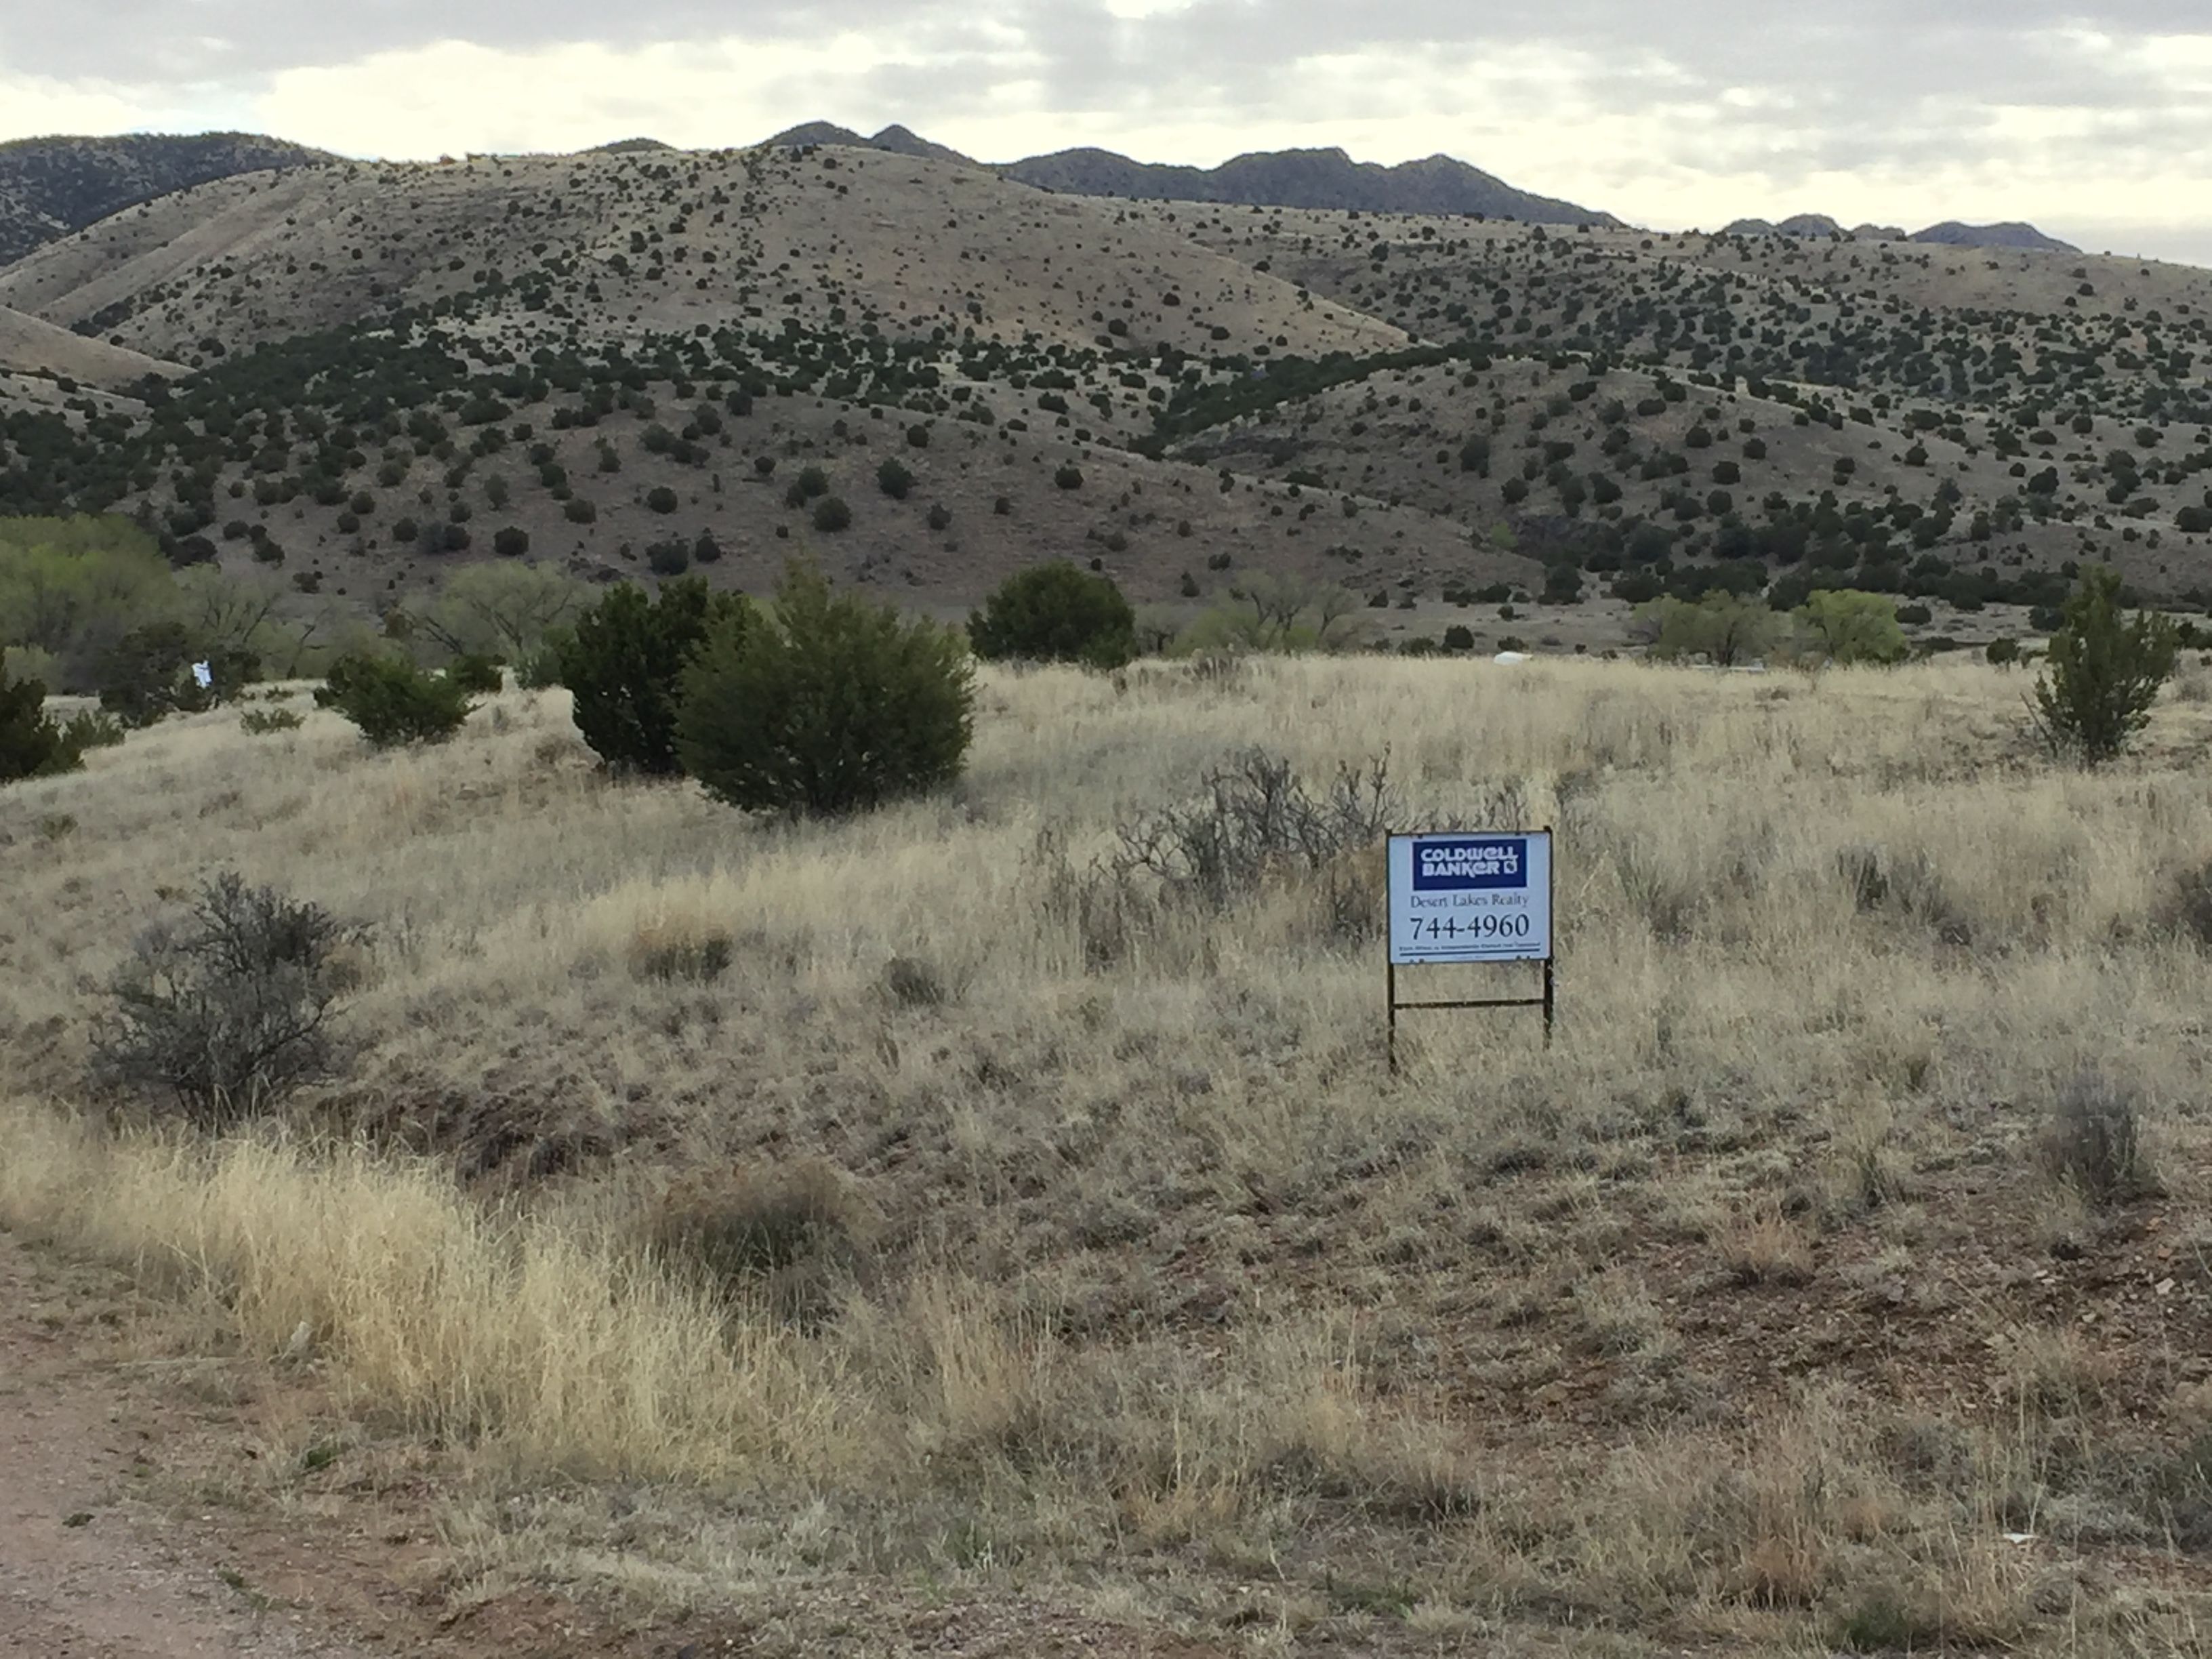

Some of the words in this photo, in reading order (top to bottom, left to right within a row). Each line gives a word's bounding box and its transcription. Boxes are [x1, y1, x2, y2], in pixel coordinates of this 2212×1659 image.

[1420, 846, 1518, 861] COLDWELL
[1422, 861, 1500, 878] BANKER
[1410, 895, 1448, 907] Desert
[1453, 894, 1488, 906] Lakes
[1492, 893, 1529, 907] Realty
[1410, 914, 1529, 940] 744-4960
